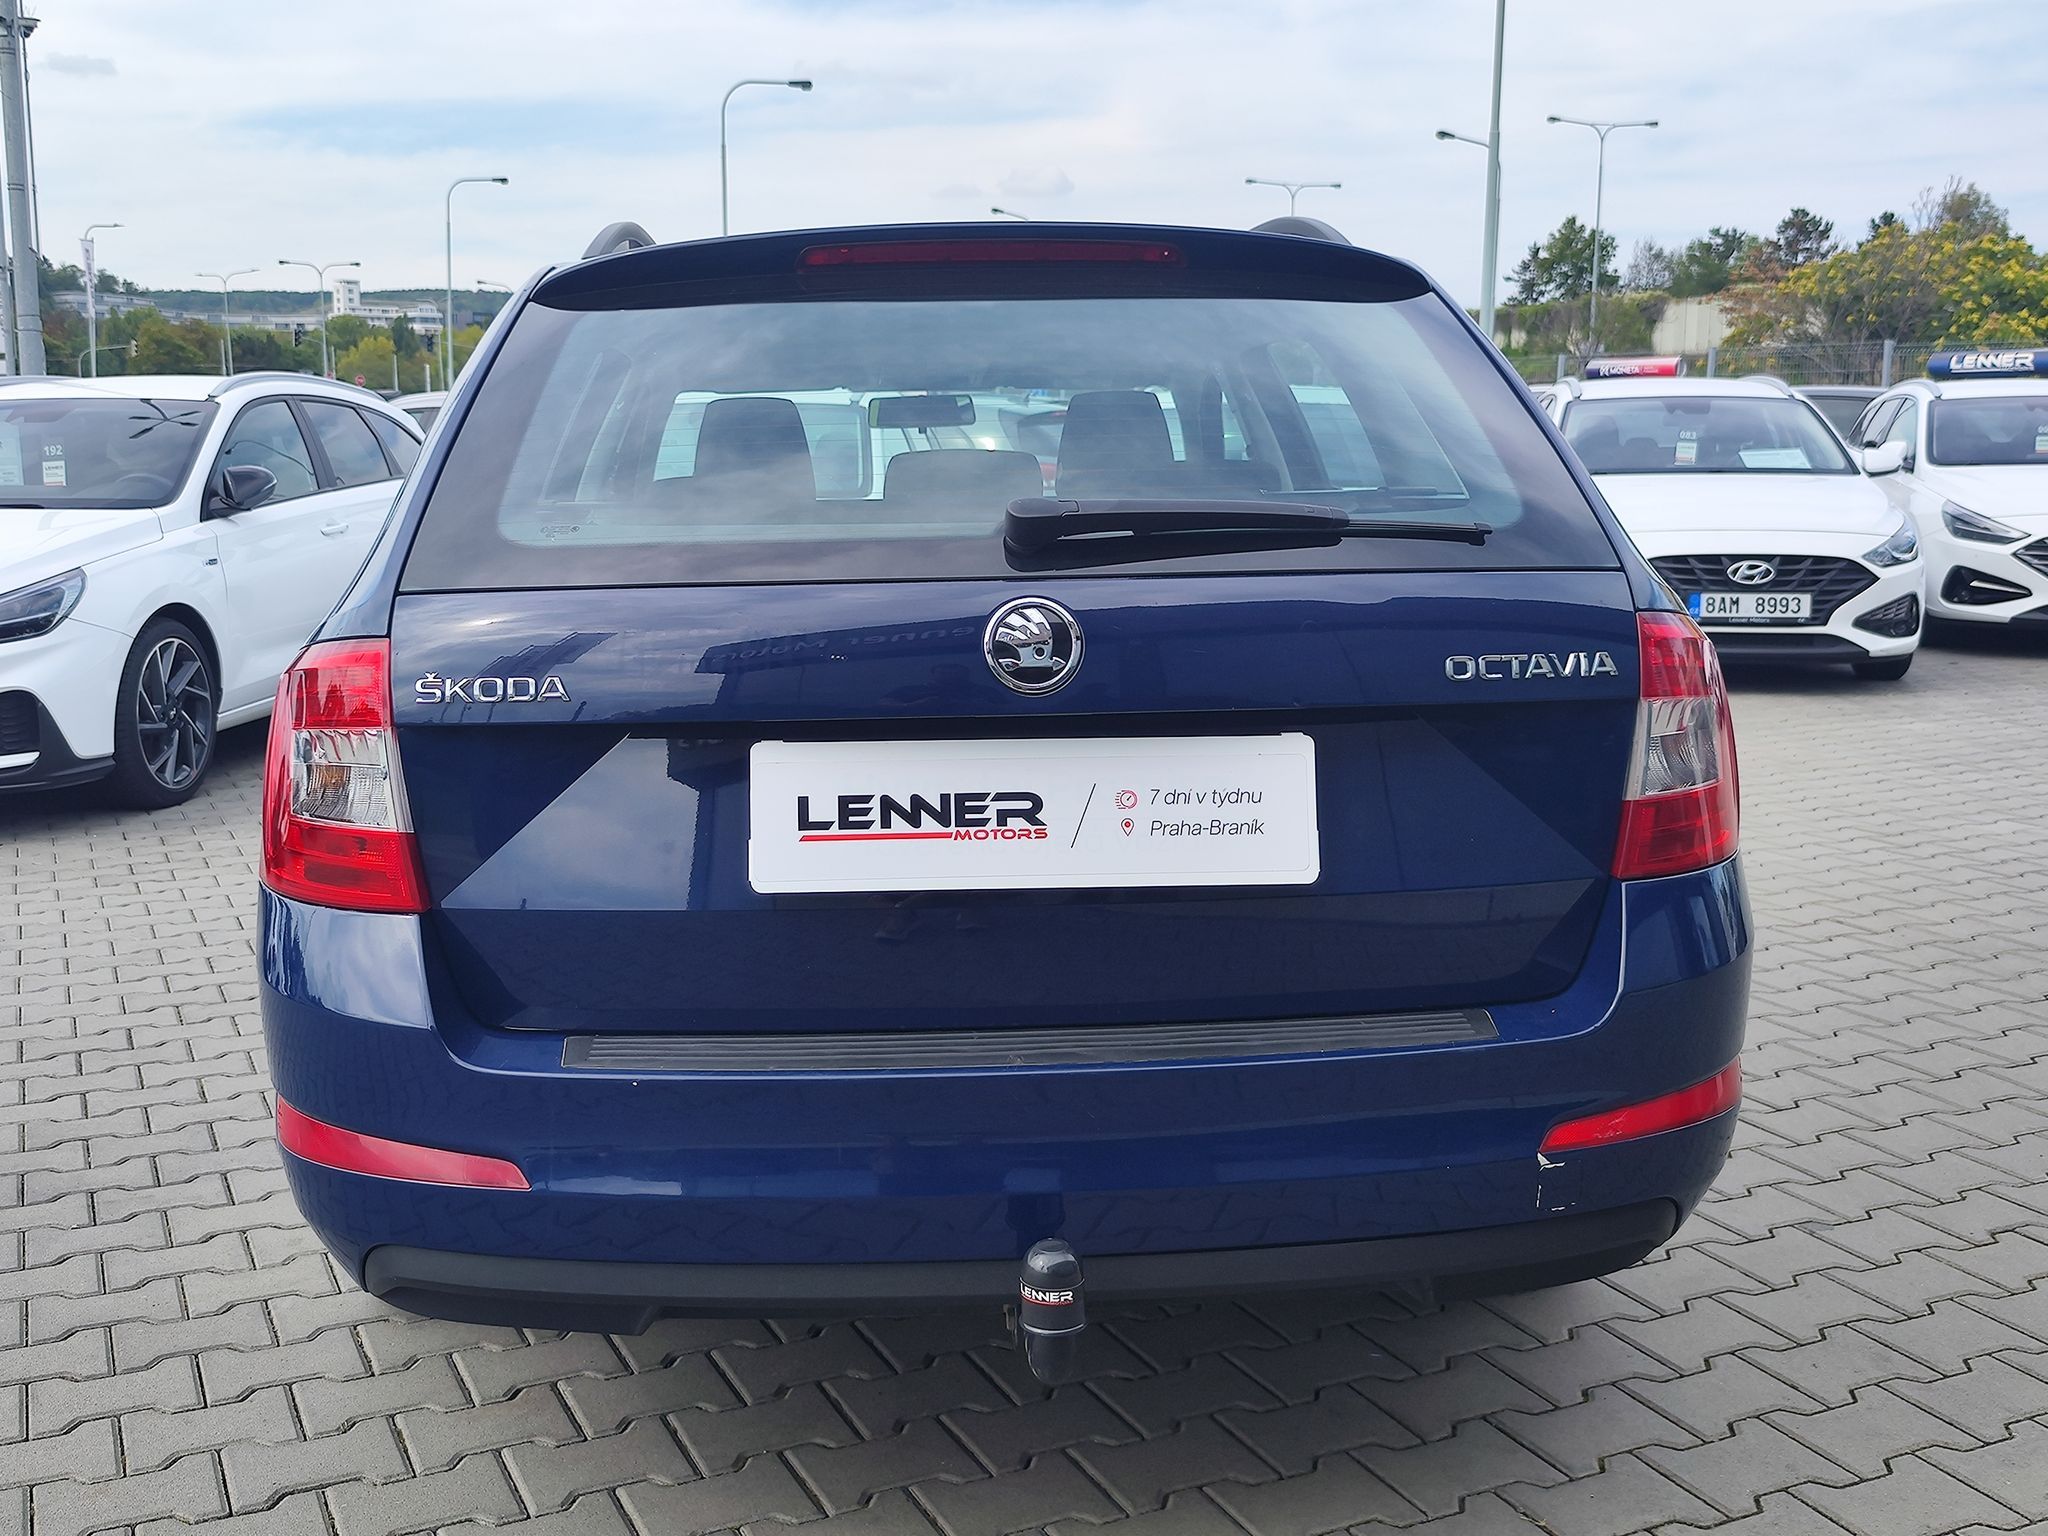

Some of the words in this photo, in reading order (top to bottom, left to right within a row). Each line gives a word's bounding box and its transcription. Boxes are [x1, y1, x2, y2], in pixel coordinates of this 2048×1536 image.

[1949, 352, 2035, 370] LENNER
[44, 444, 63, 456] 192
[1705, 596, 1740, 614] 8AM
[1755, 596, 1801, 614] 8993
[1445, 652, 1619, 681] OCTAVIA
[415, 672, 571, 704] ŠKODA
[1150, 789, 1160, 805] 7
[1164, 788, 1193, 805] dní
[1196, 792, 1207, 804] v
[1212, 787, 1263, 808] týdnu
[797, 791, 1048, 831] LENNER
[953, 828, 1048, 842] MOTORS
[1150, 819, 1265, 837] Praha-Braník
[1020, 1282, 1073, 1302] LENNER
